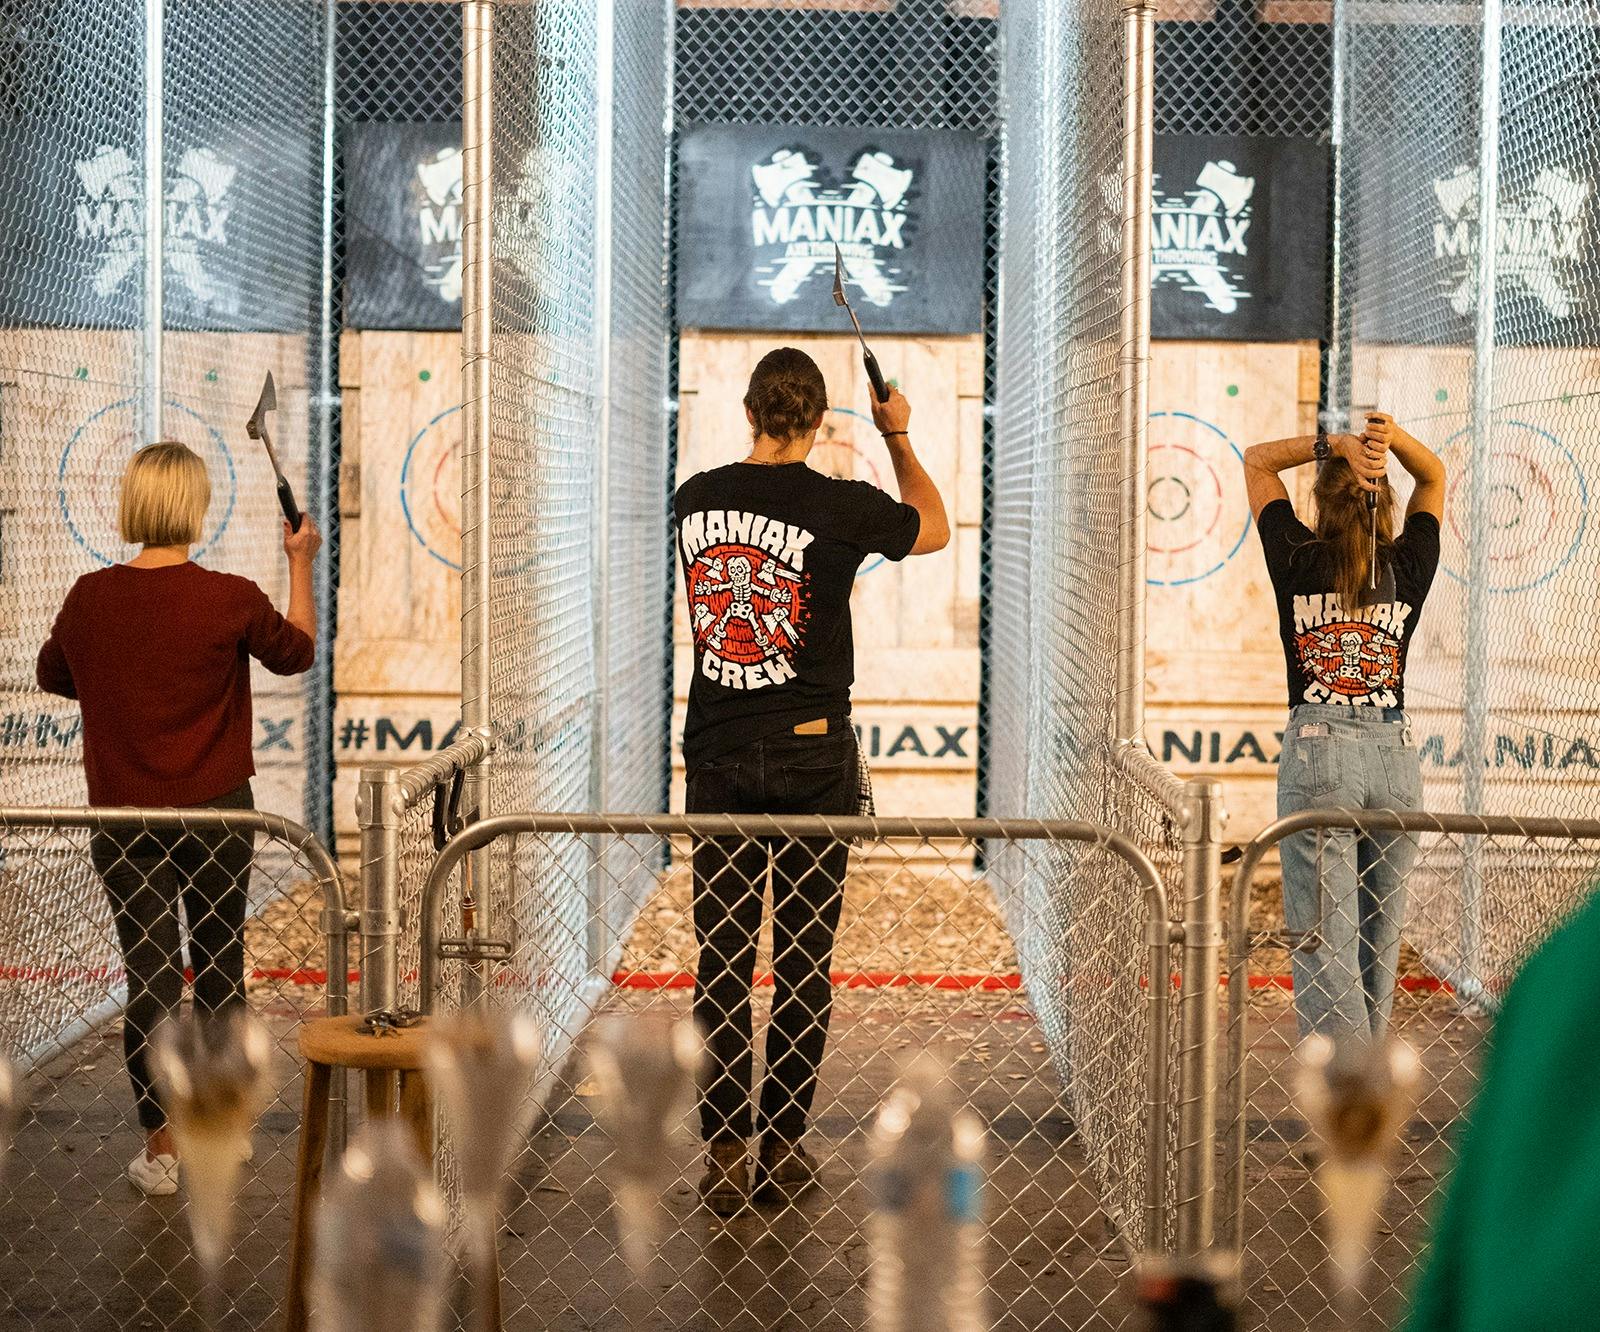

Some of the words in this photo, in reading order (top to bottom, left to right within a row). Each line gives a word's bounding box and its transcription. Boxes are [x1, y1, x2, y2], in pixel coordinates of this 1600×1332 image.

[76, 201, 229, 246] MAIAX
[752, 205, 907, 249] MANIAX
[1152, 213, 1251, 256] NIAX
[1433, 220, 1583, 260] MNIAX
[702, 649, 798, 690] CREW
